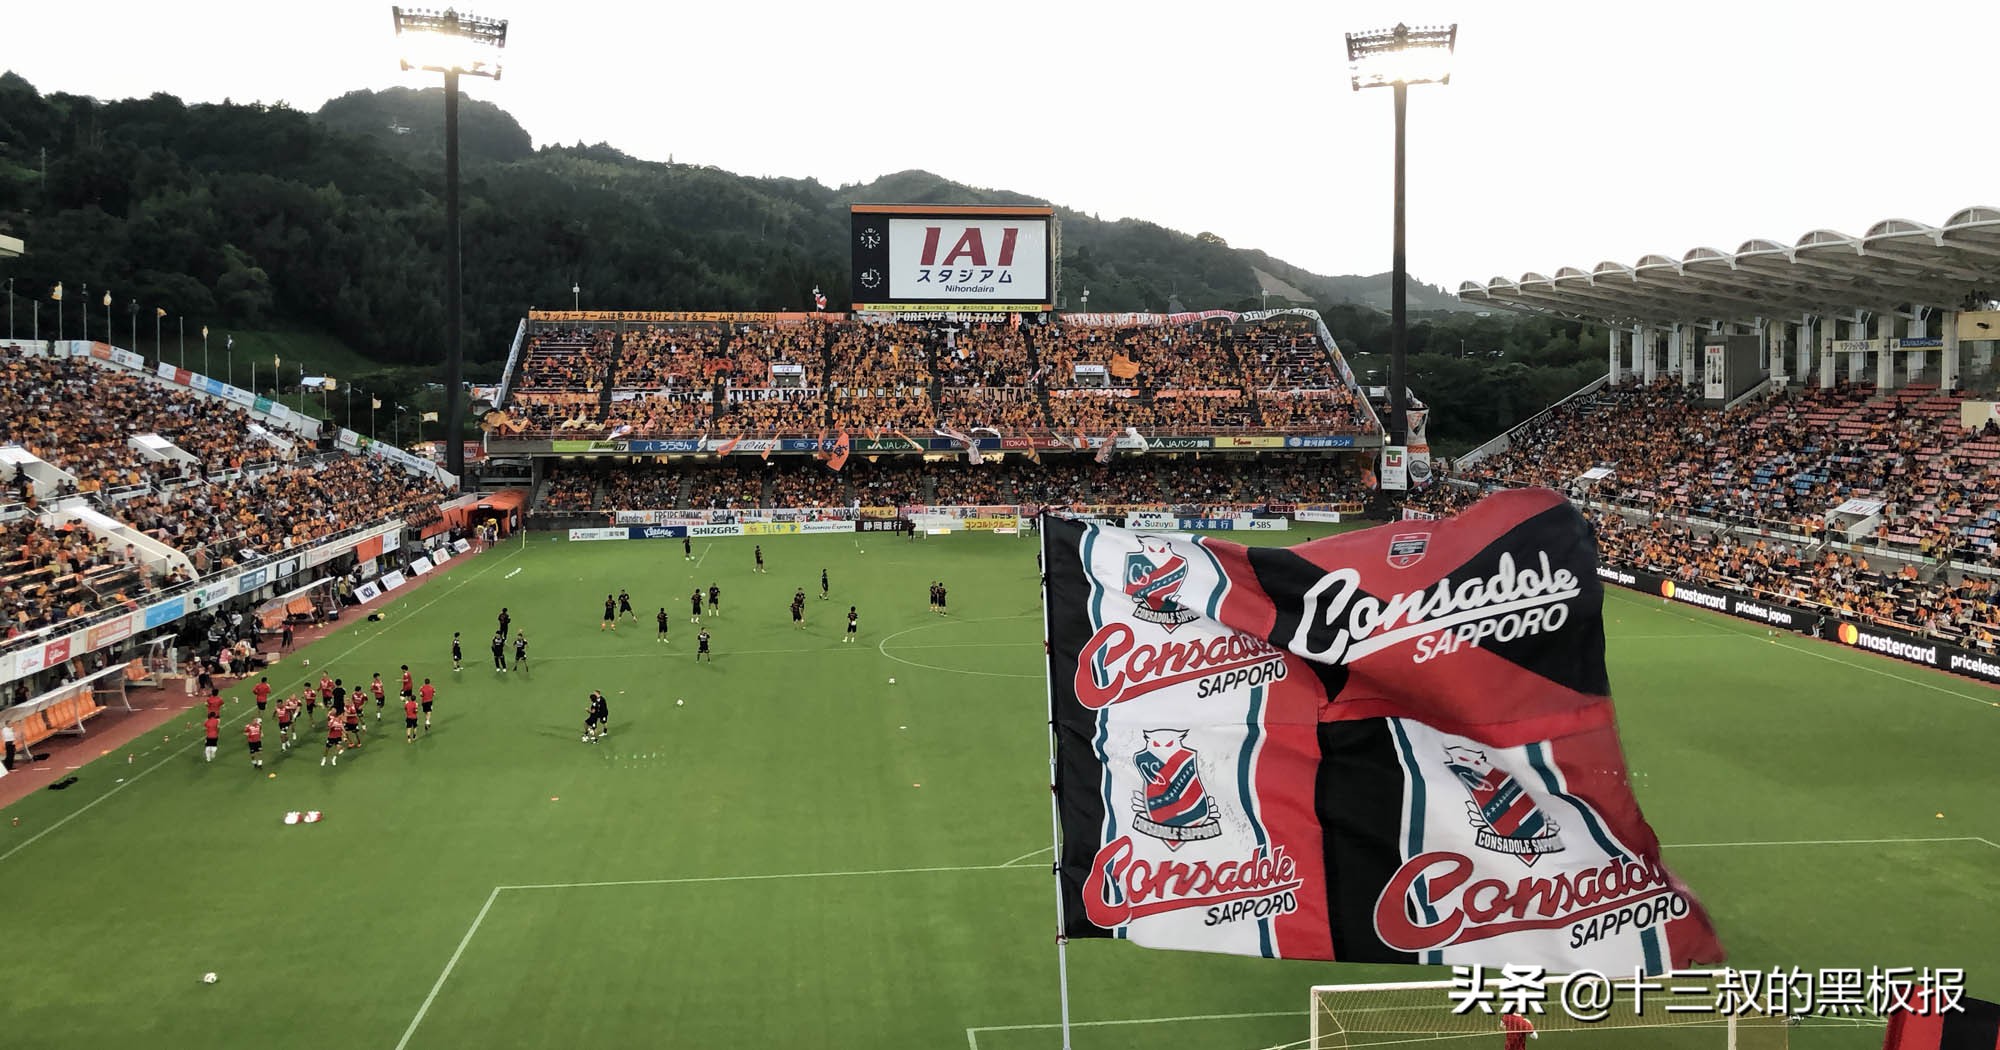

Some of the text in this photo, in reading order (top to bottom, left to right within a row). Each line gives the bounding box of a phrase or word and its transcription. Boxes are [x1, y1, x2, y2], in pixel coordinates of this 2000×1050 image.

[920, 227, 1018, 266] IAI
[917, 270, 1012, 283] スタジアム
[945, 284, 995, 293] Nihondaira
[958, 312, 1007, 322] ULTRAS
[1063, 315, 1102, 327] ULTRAS
[1114, 313, 1136, 327] NOT
[1136, 313, 1162, 325] DEAD
[730, 389, 765, 402] THE
[660, 441, 693, 451] ろうきん
[617, 511, 644, 523] Leandro
[692, 526, 740, 535] SHIZGAS
[863, 521, 902, 531] 静岡銀行
[1144, 520, 1174, 529] Suzuyo
[1183, 520, 1230, 529] 清水銀行
[1256, 521, 1272, 529] SBS
[643, 527, 674, 538] Kleenex
[1618, 571, 1636, 585] japan
[1675, 587, 1727, 610] mastercard
[1288, 551, 1582, 664] Consadole
[1735, 601, 1792, 625] priceless japan
[1413, 603, 1568, 664] SAPPORO
[1859, 632, 1937, 665] mastercard
[1951, 654, 2000, 678] priceless
[1197, 660, 1286, 699] SAPPORO
[1478, 832, 1531, 854] CONSADOLE
[1083, 836, 1302, 928] Consadole
[1205, 891, 1296, 927] SAPPORO
[1570, 893, 1688, 949] SAPPORO
